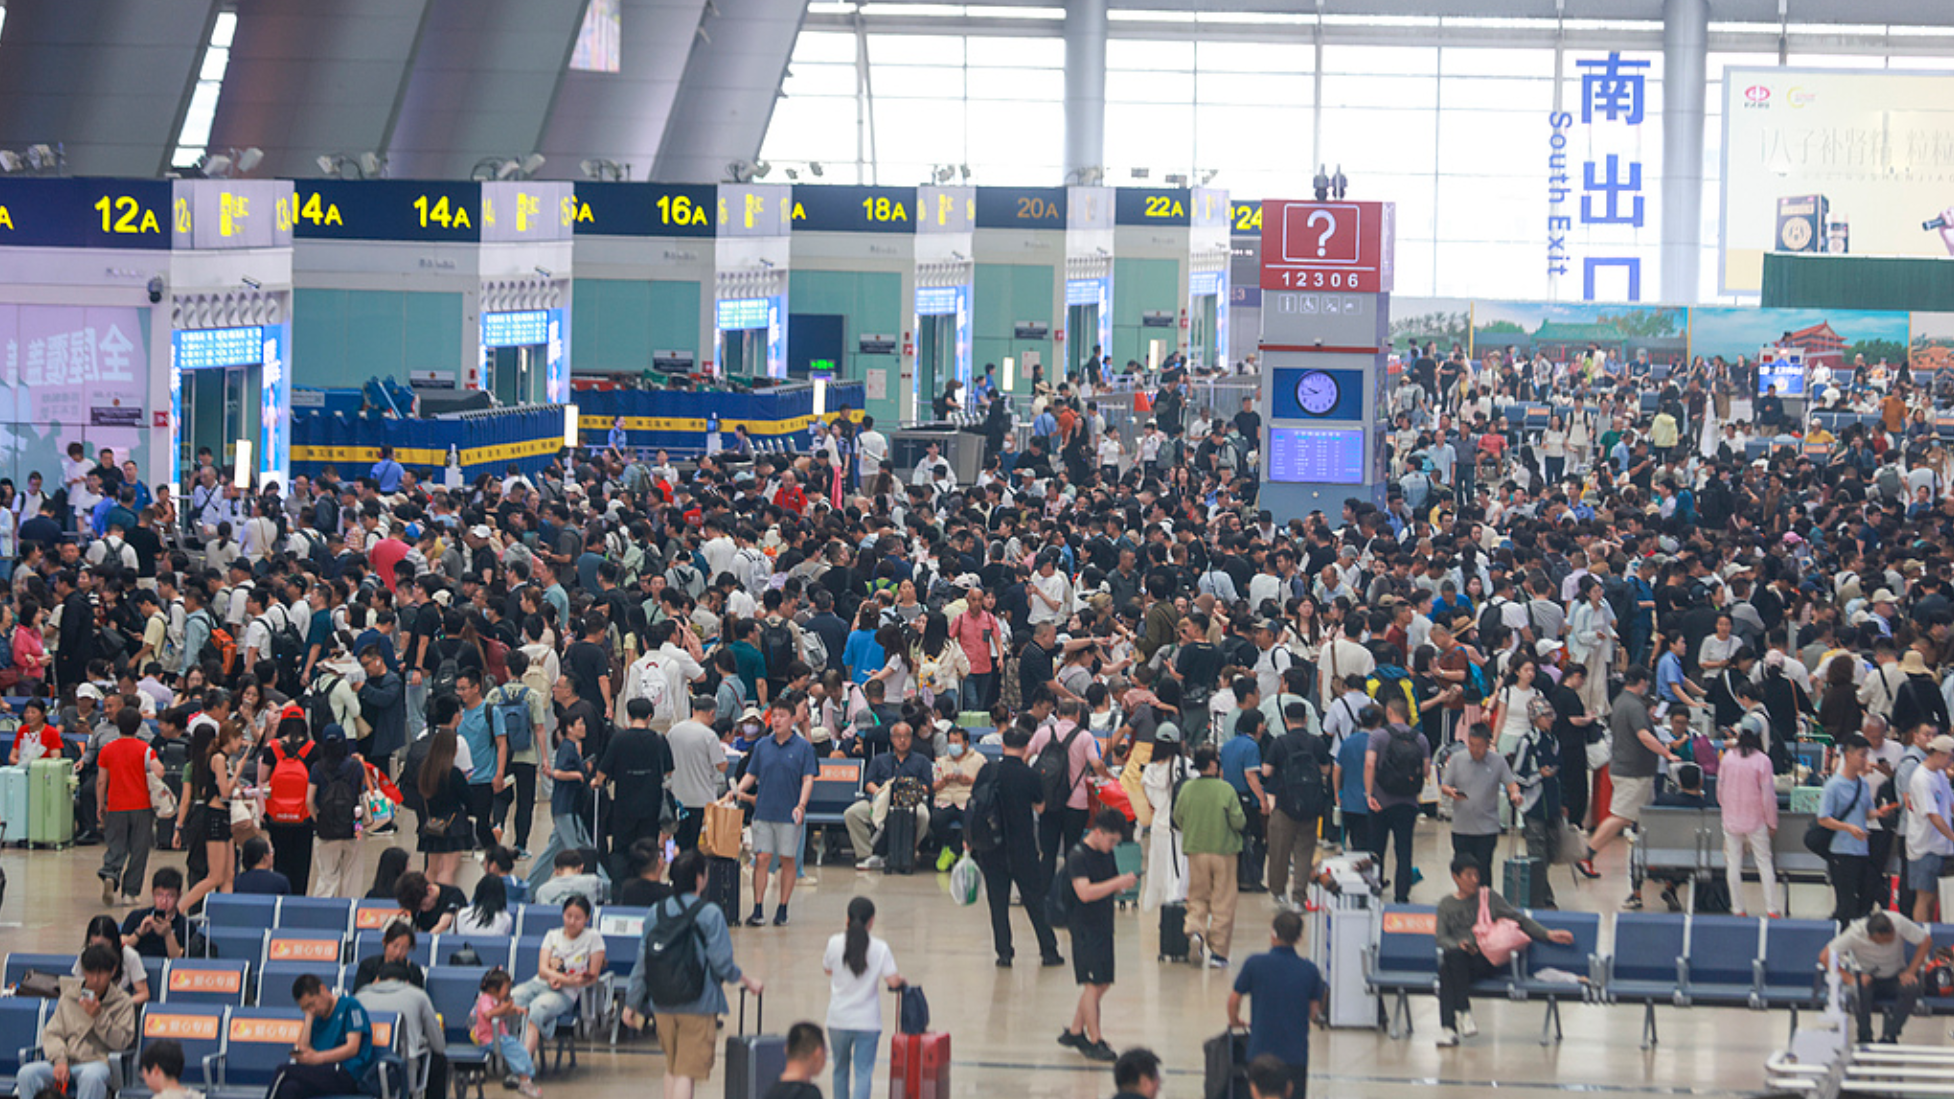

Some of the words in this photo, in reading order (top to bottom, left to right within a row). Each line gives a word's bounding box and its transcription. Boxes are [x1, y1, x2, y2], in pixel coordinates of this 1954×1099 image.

[1549, 111, 1573, 203] South
[1576, 52, 1651, 300] 南出口
[95, 196, 160, 233] 12A
[413, 196, 471, 228] 14A
[656, 196, 707, 226] 16A
[862, 198, 907, 222] 18A
[1017, 198, 1059, 219] 20A
[1145, 197, 1184, 217] 22A
[1548, 216, 1571, 276] Exit
[1282, 271, 1359, 287] 12306
[292, 944, 334, 956] 爱心专座
[194, 974, 236, 985] 爱心专座
[169, 1019, 215, 1032] 爱心专座
